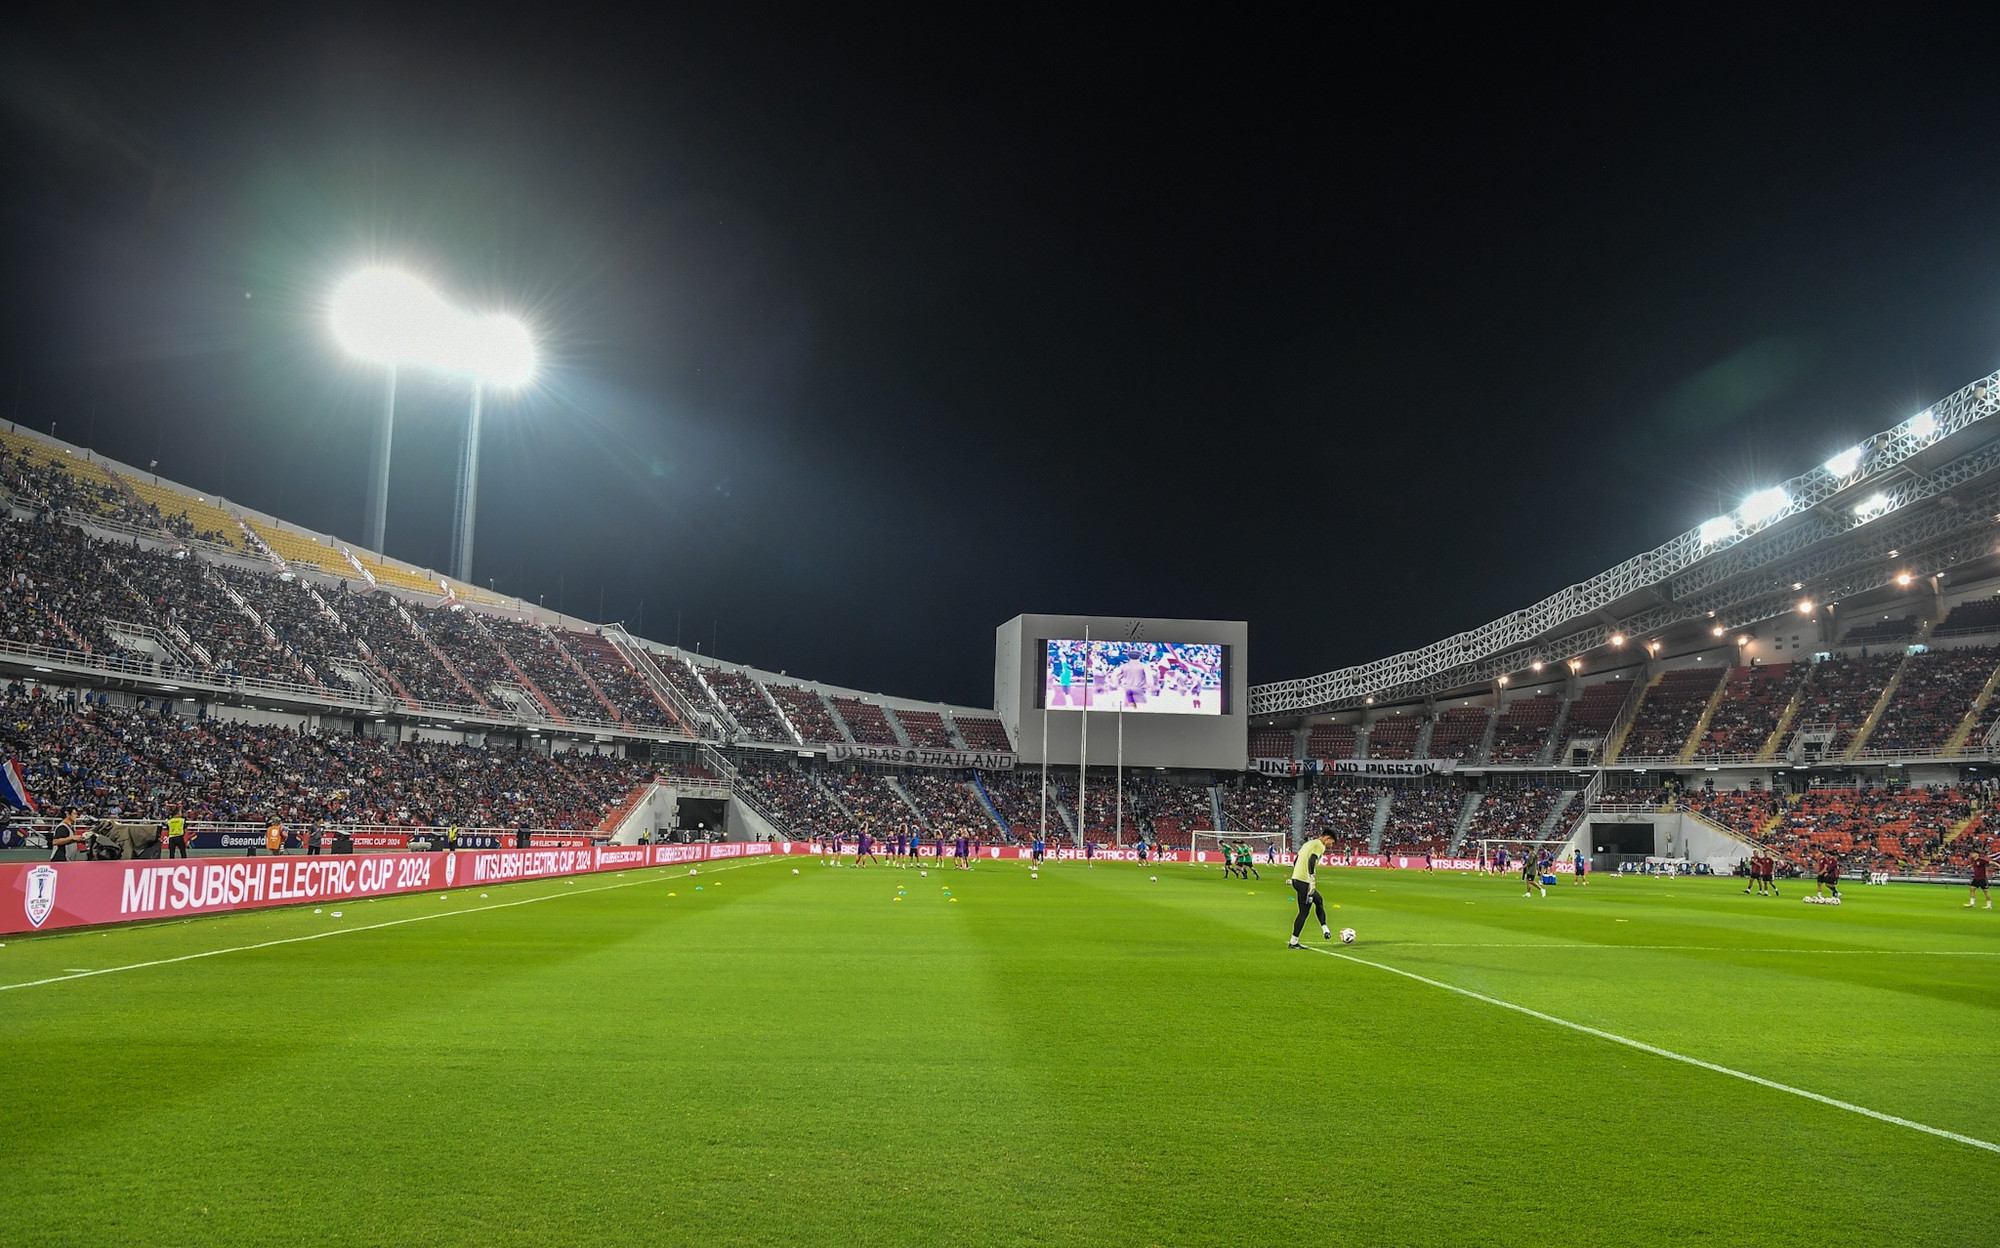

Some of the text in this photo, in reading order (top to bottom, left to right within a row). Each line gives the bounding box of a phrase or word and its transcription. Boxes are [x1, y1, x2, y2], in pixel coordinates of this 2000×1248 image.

[920, 752, 1012, 768] THAILAND
[1260, 760, 1315, 774] UNITY
[1321, 763, 1358, 773] AND
[474, 853, 524, 880] MITSUBISHI
[524, 851, 559, 875] ELECTRIC
[560, 850, 575, 872] CUP
[576, 850, 591, 870] 2024
[1356, 857, 1380, 867] 2024
[121, 863, 266, 913] MITSUBISHI
[268, 859, 356, 900] ELECTRIC
[359, 858, 394, 892] CUP
[397, 858, 431, 888] 2024
